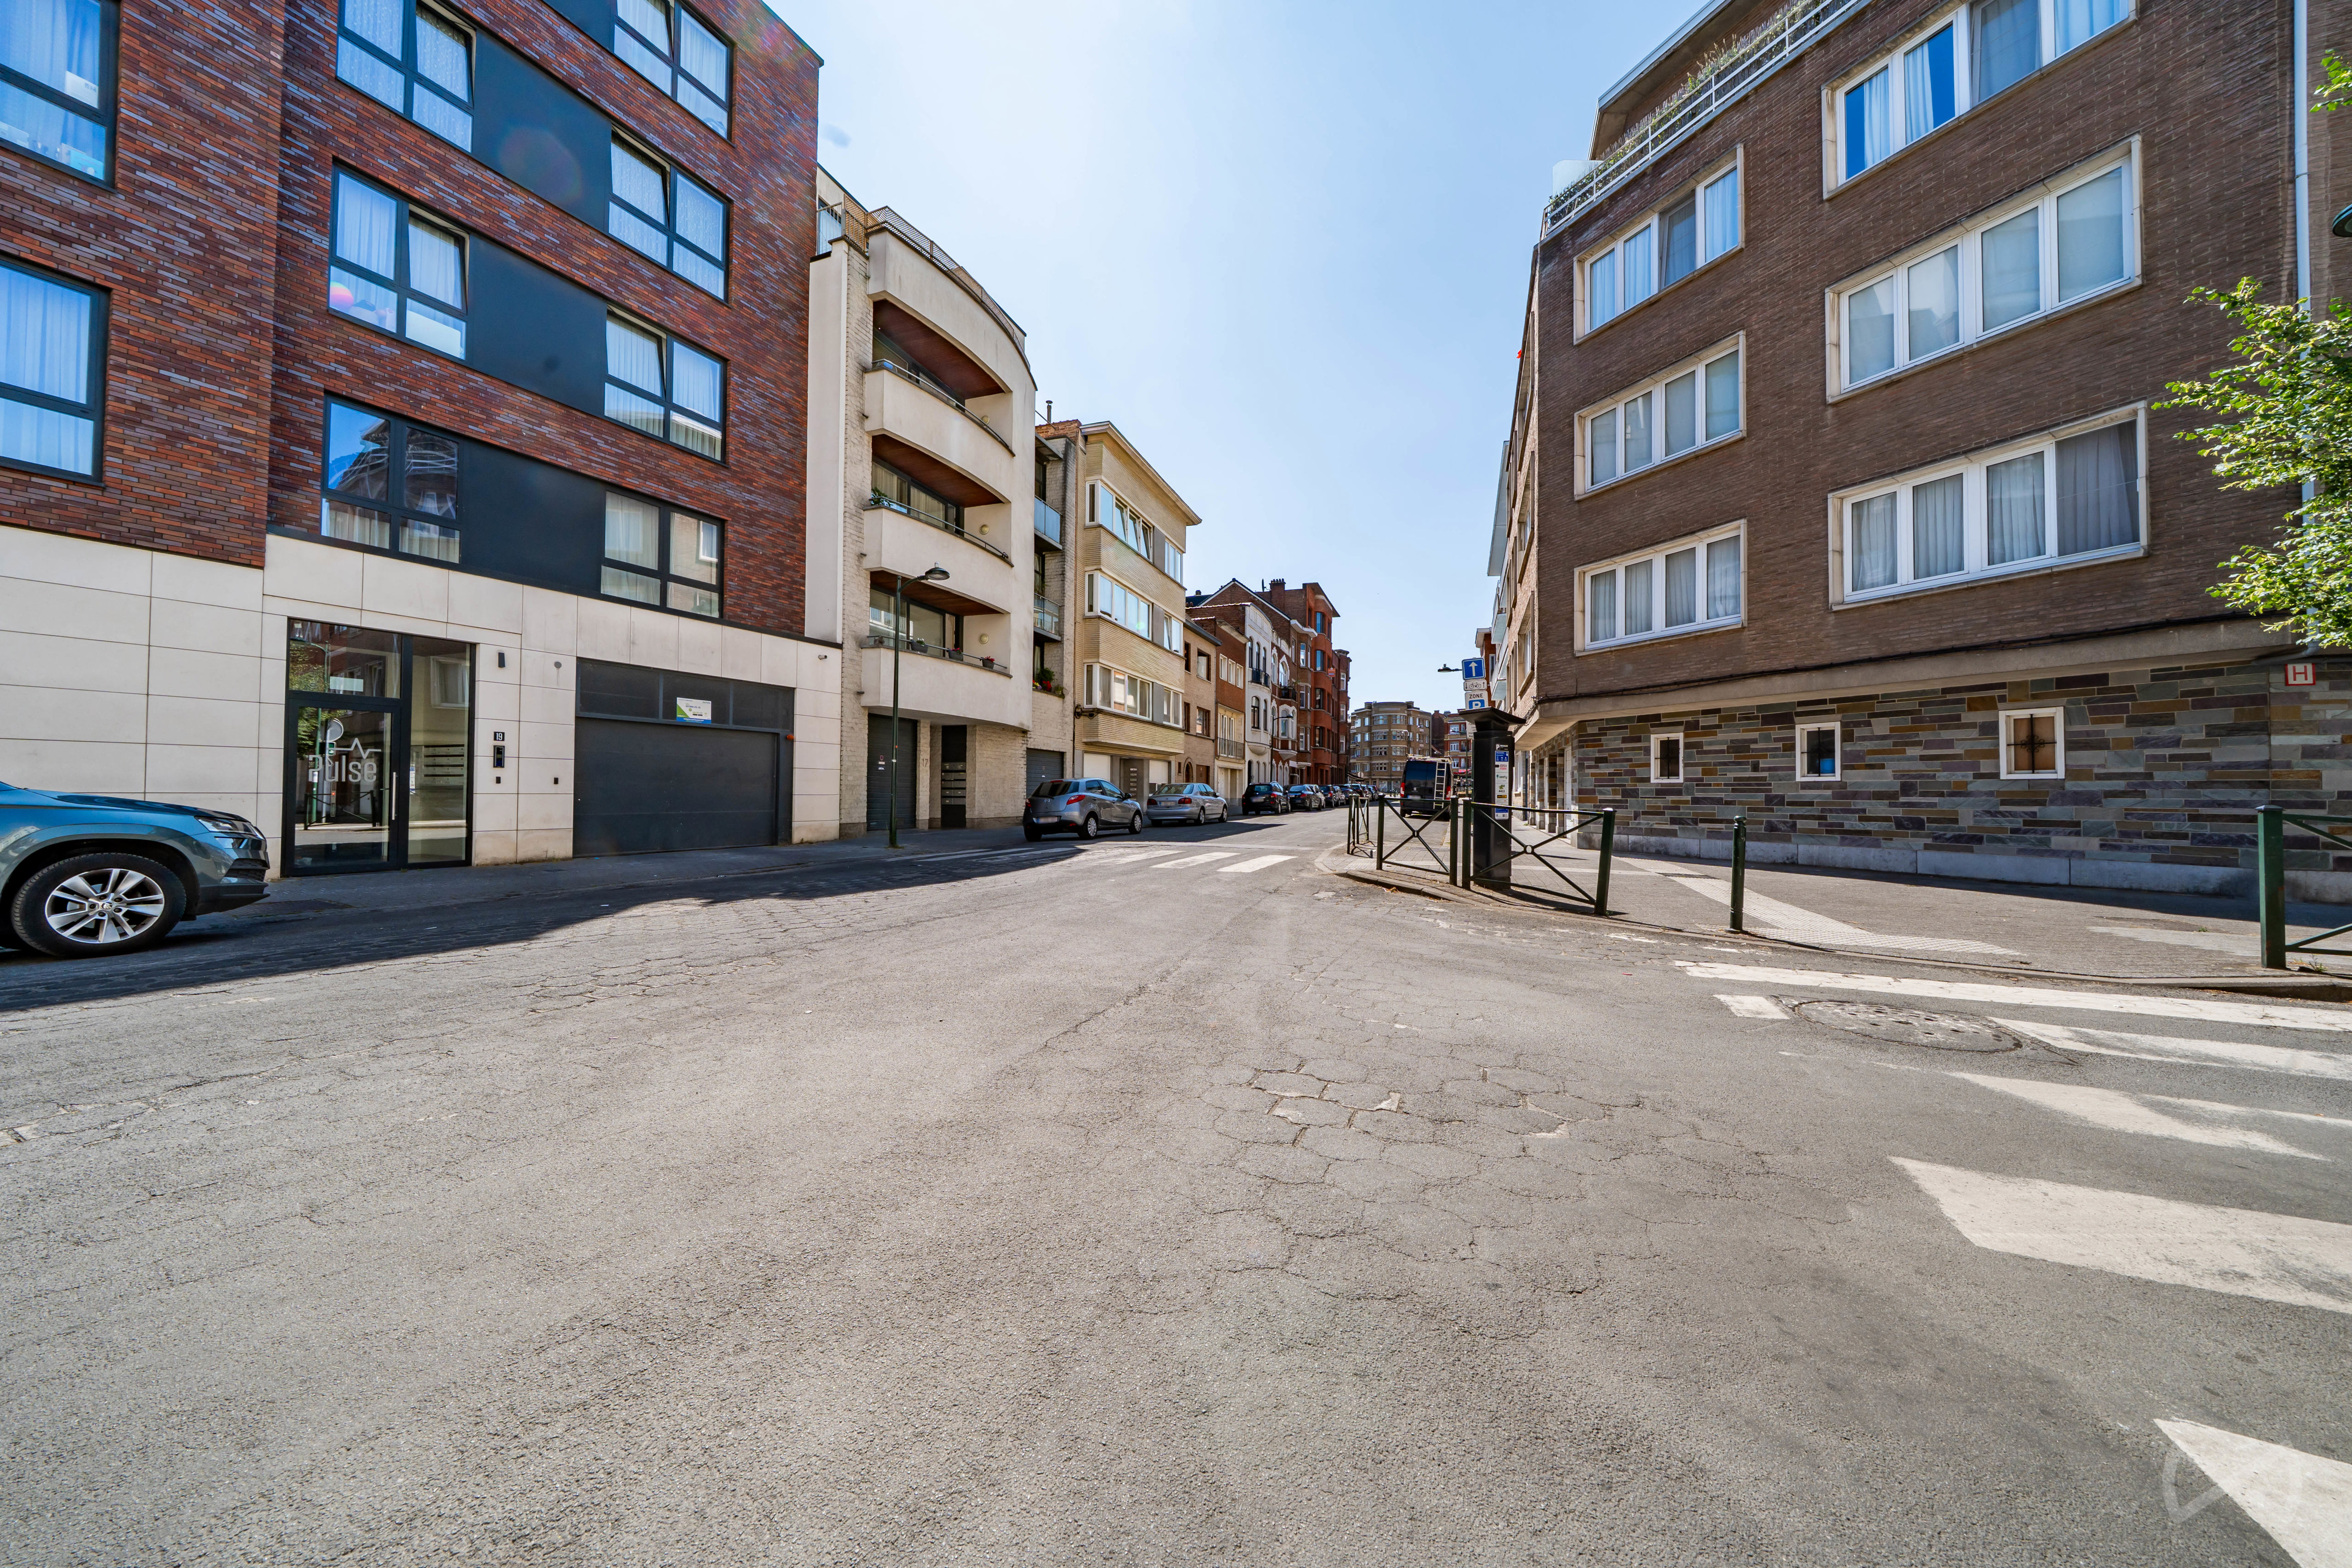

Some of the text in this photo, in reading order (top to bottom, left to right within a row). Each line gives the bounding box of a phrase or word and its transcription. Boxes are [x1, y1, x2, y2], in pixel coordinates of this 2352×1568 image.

[2292, 665, 2308, 681] H
[496, 732, 503, 741] 19
[308, 755, 377, 782] Pulse
[922, 758, 928, 767] 17
